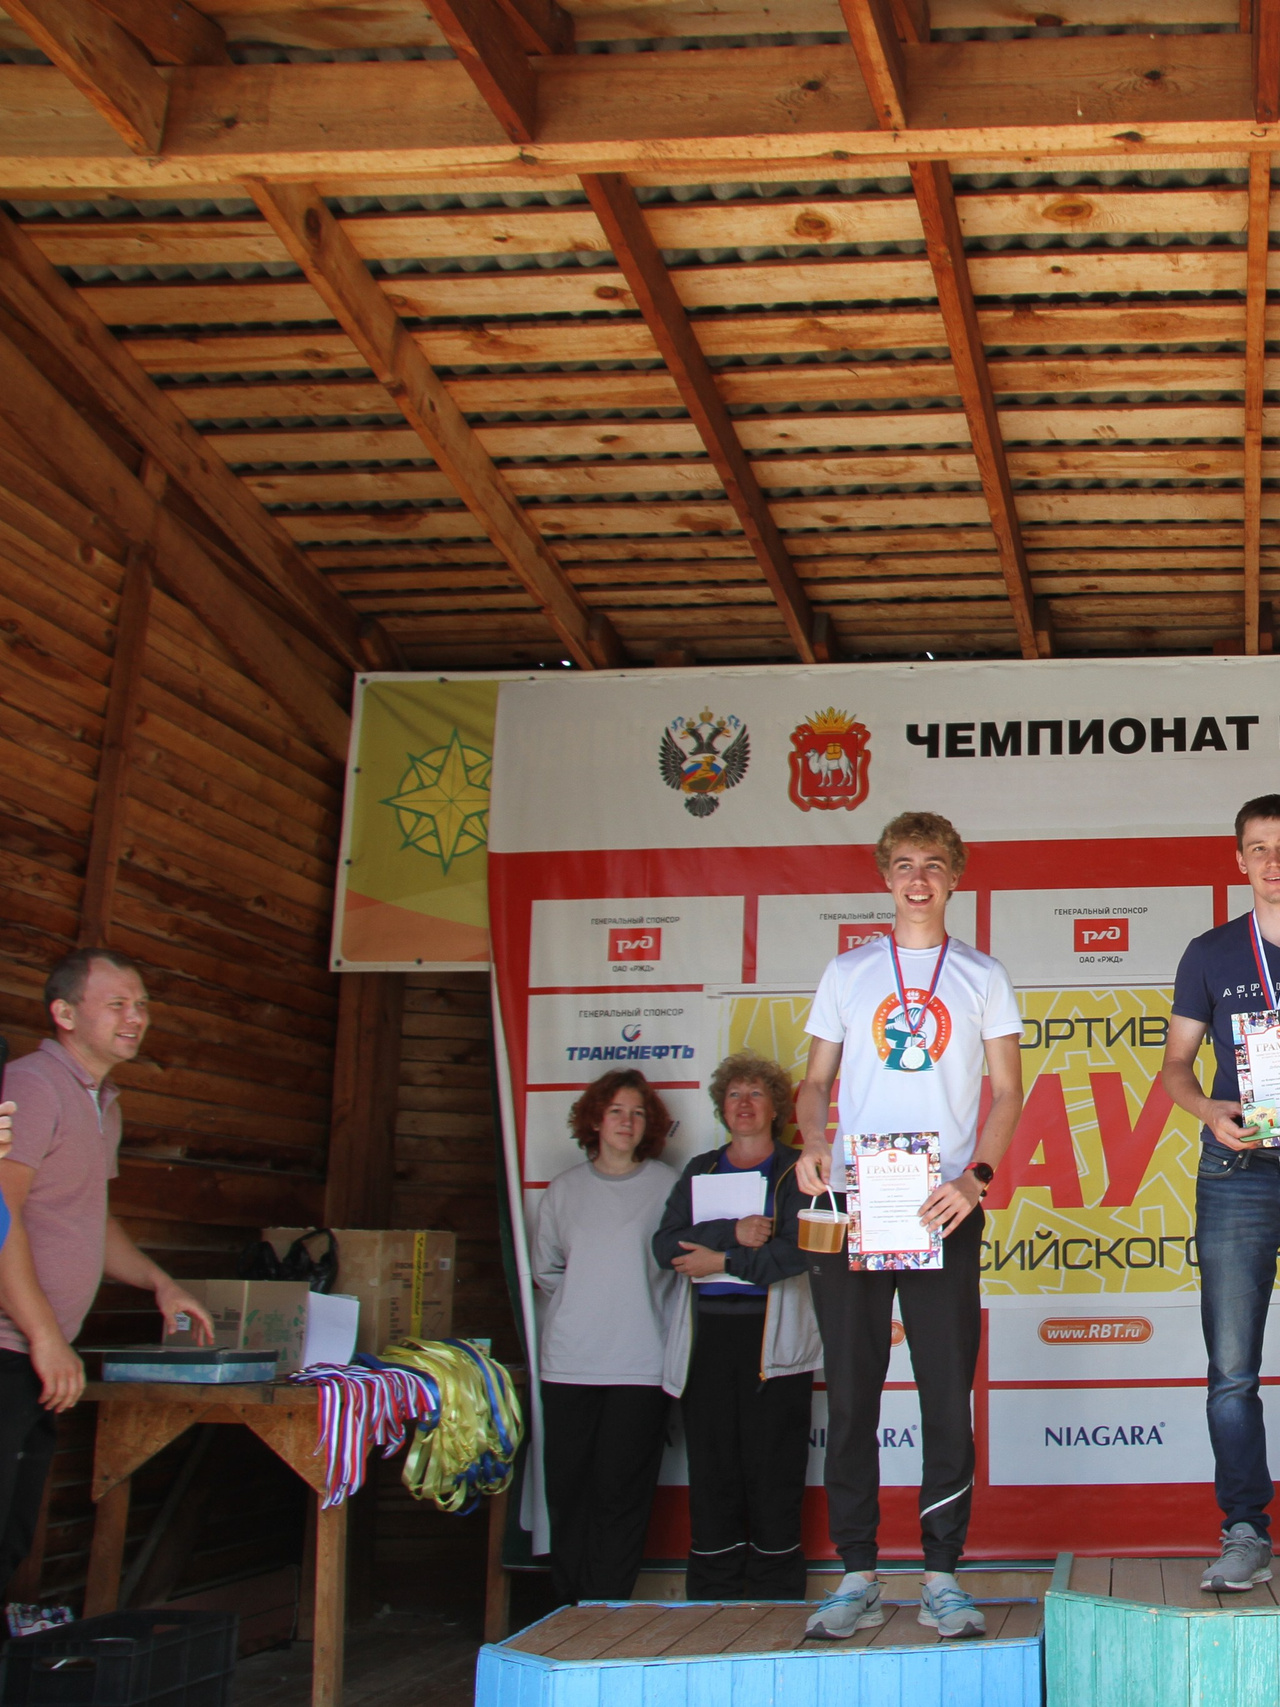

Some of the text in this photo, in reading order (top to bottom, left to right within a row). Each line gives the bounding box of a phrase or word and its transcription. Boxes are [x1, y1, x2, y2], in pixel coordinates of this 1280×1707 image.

[906, 715, 1259, 759] ЧЕМПИОНАТ
[819, 912, 896, 920] ГЕНЕРАЛЬНЫЙ СПОН
[1054, 906, 1148, 915] ГЕНЕРАЛЬНЫЙ СПОНСОР
[591, 916, 680, 925] ГЕНЕРАЛЬНЫЙ СПОНСОР
[579, 1008, 684, 1018] ГЕНЕРАЛЬНЫЙ СПОНСОР
[1018, 1016, 1169, 1050] ОРТИВ
[566, 1045, 695, 1061] ТРАНСНЕФТЬ
[866, 1164, 920, 1175] ГРАМОТА
[980, 1231, 1199, 1271] ИЙСКОГ
[1047, 1324, 1140, 1339] www.RBT.ru
